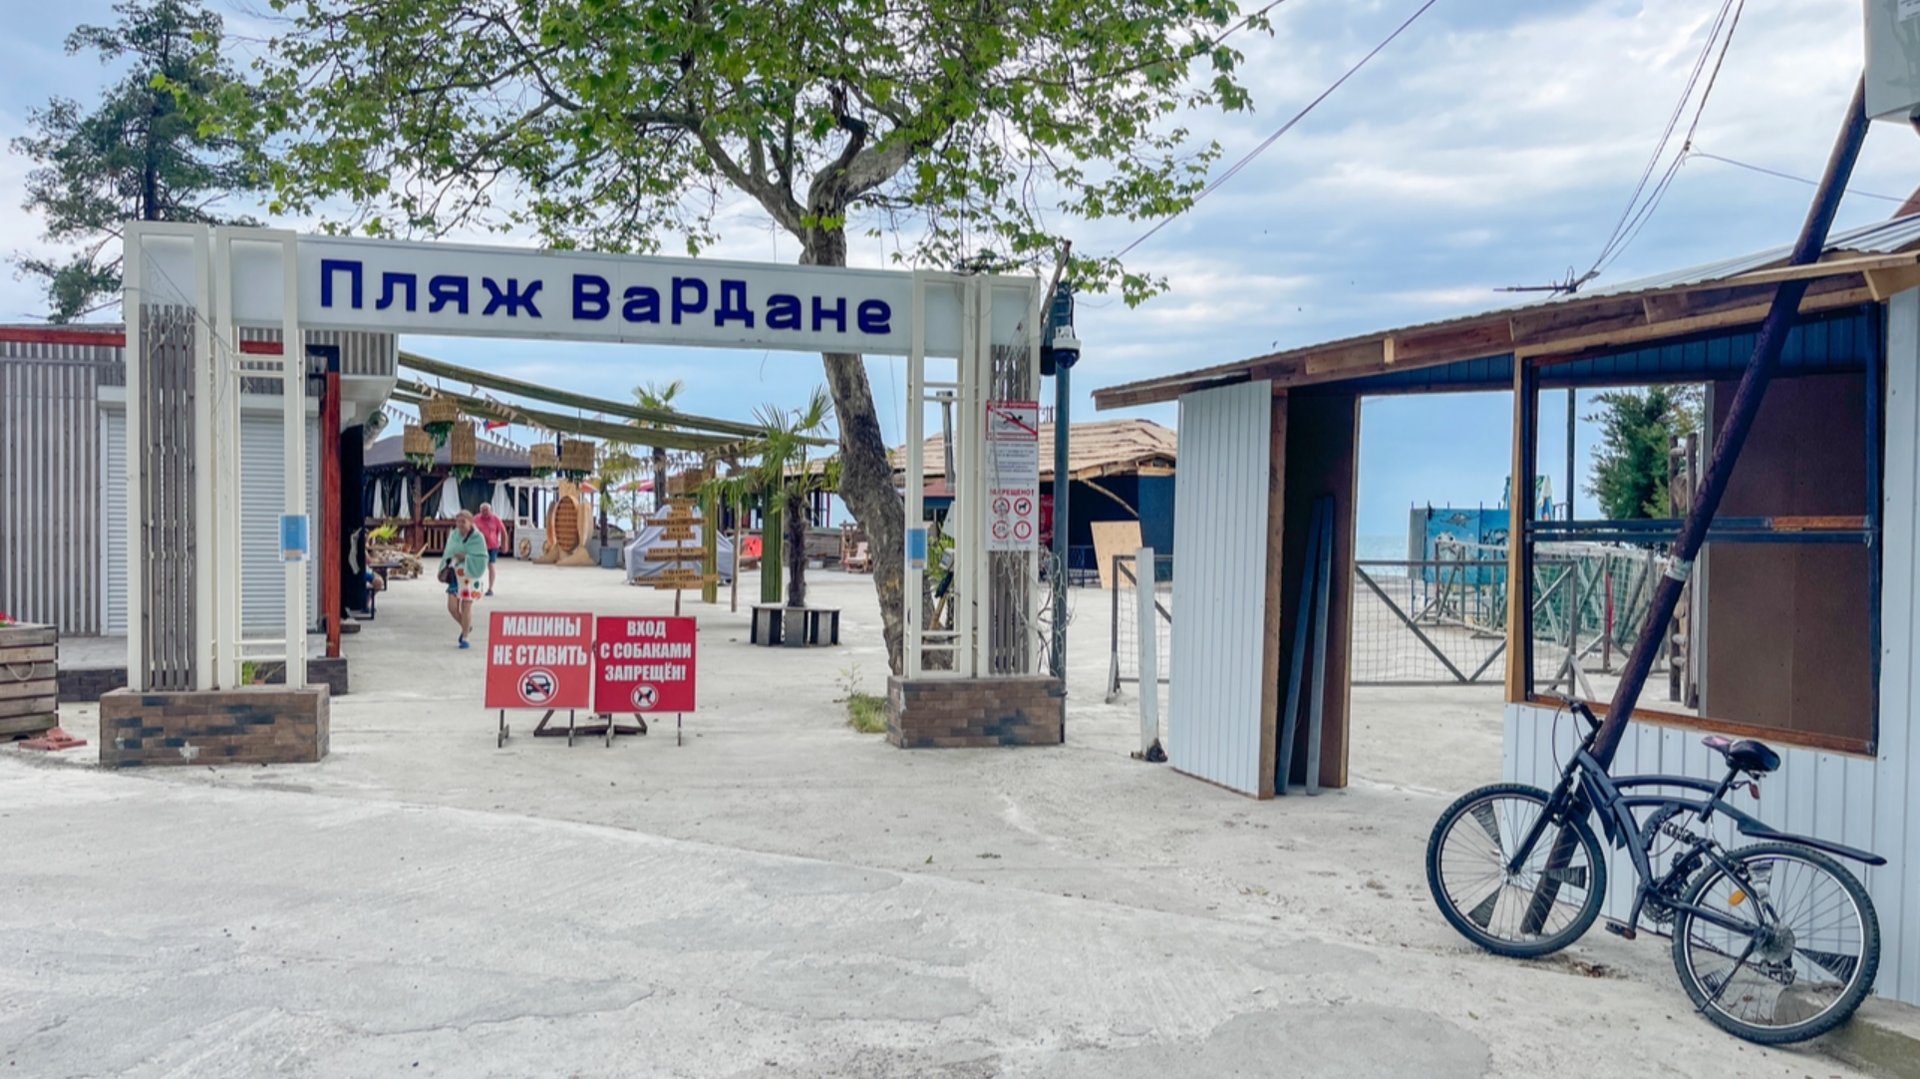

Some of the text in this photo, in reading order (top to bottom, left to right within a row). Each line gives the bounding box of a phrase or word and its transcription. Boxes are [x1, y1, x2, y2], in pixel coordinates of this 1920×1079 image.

[320, 258, 891, 335] Пляж Вардане
[502, 616, 581, 637] МАШИНЫ
[627, 621, 666, 639] ВХОД
[493, 645, 588, 666] НЕ СТАВИТЬ
[600, 643, 692, 659] С СОБАКАМИ
[605, 663, 687, 683] ЗАПРЕЩЁН!
